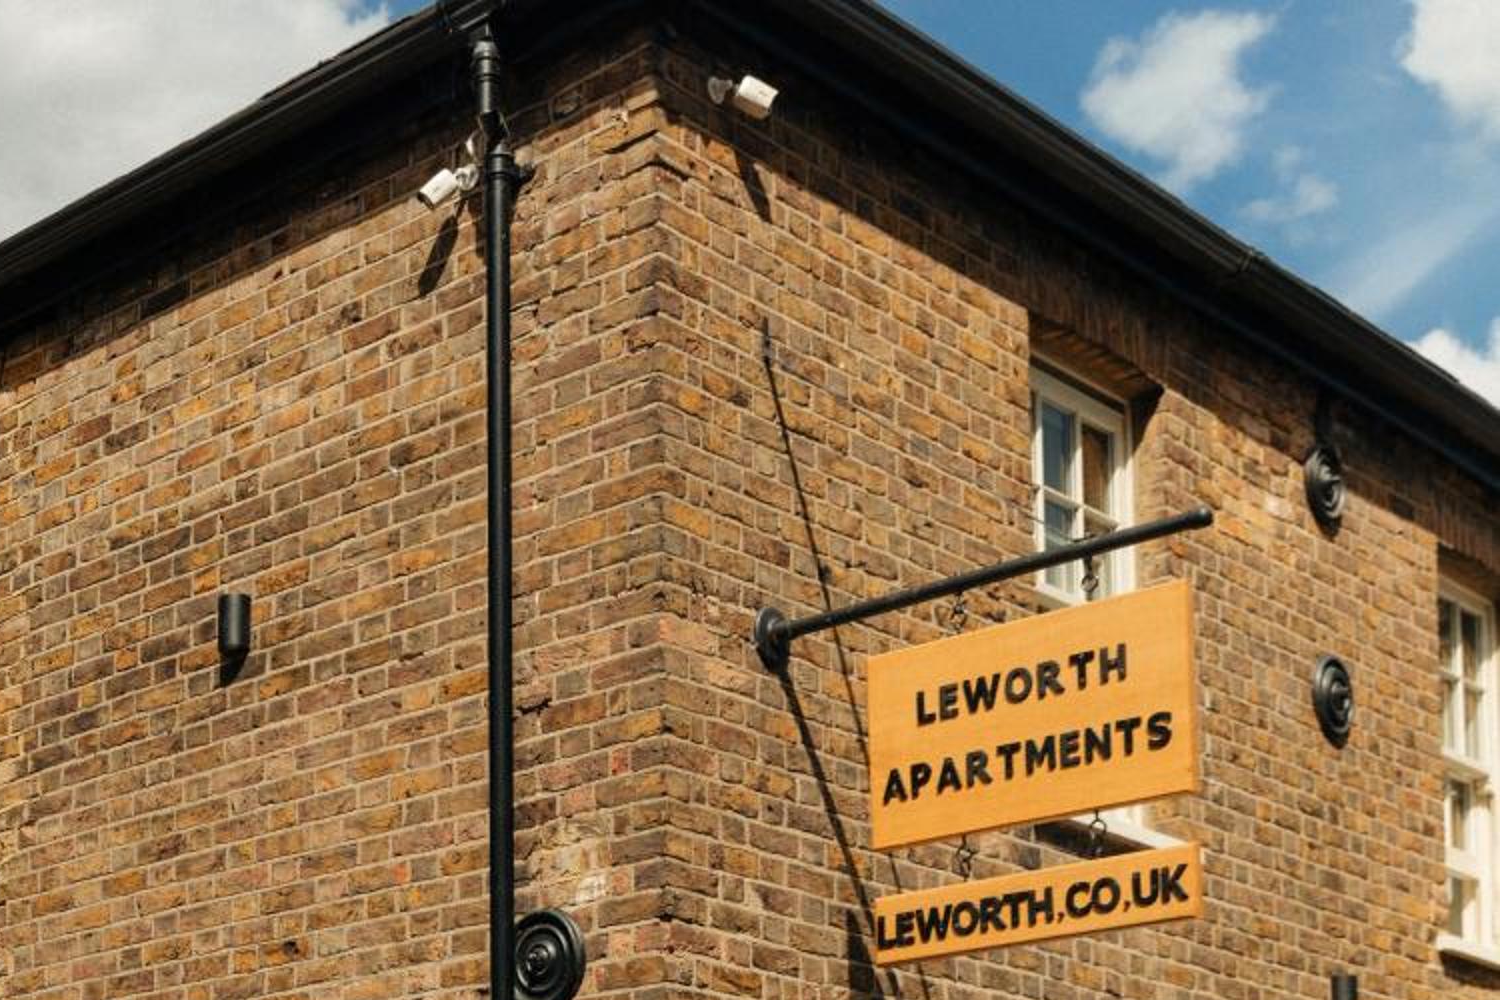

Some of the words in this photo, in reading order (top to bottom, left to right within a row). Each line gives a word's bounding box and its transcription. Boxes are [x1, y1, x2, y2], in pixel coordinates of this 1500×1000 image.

[916, 643, 1127, 726] LEWORTH
[883, 711, 1172, 805] APARTMENTS
[877, 863, 1189, 951] LEWORTH.CO.UK
